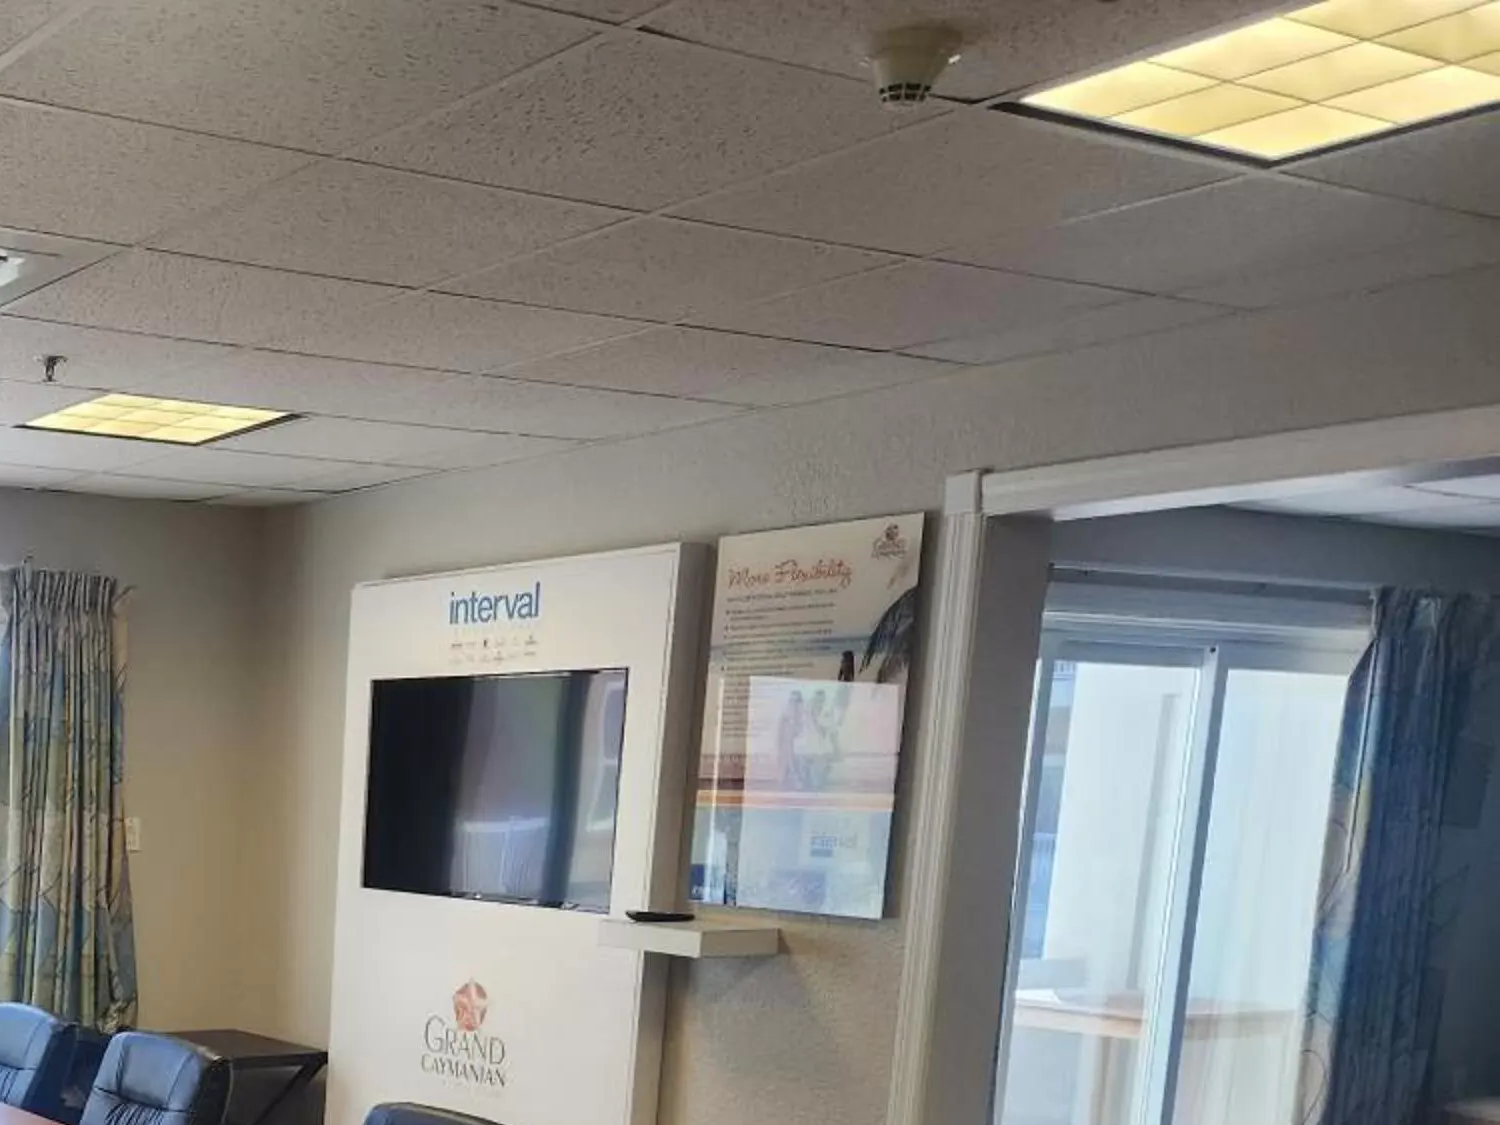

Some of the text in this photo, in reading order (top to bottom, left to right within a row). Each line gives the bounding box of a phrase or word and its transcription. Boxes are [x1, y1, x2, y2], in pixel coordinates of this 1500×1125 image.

[449, 581, 541, 625] interval
[424, 1014, 506, 1065] GRAND
[421, 1053, 506, 1088] CAYMANIAN
